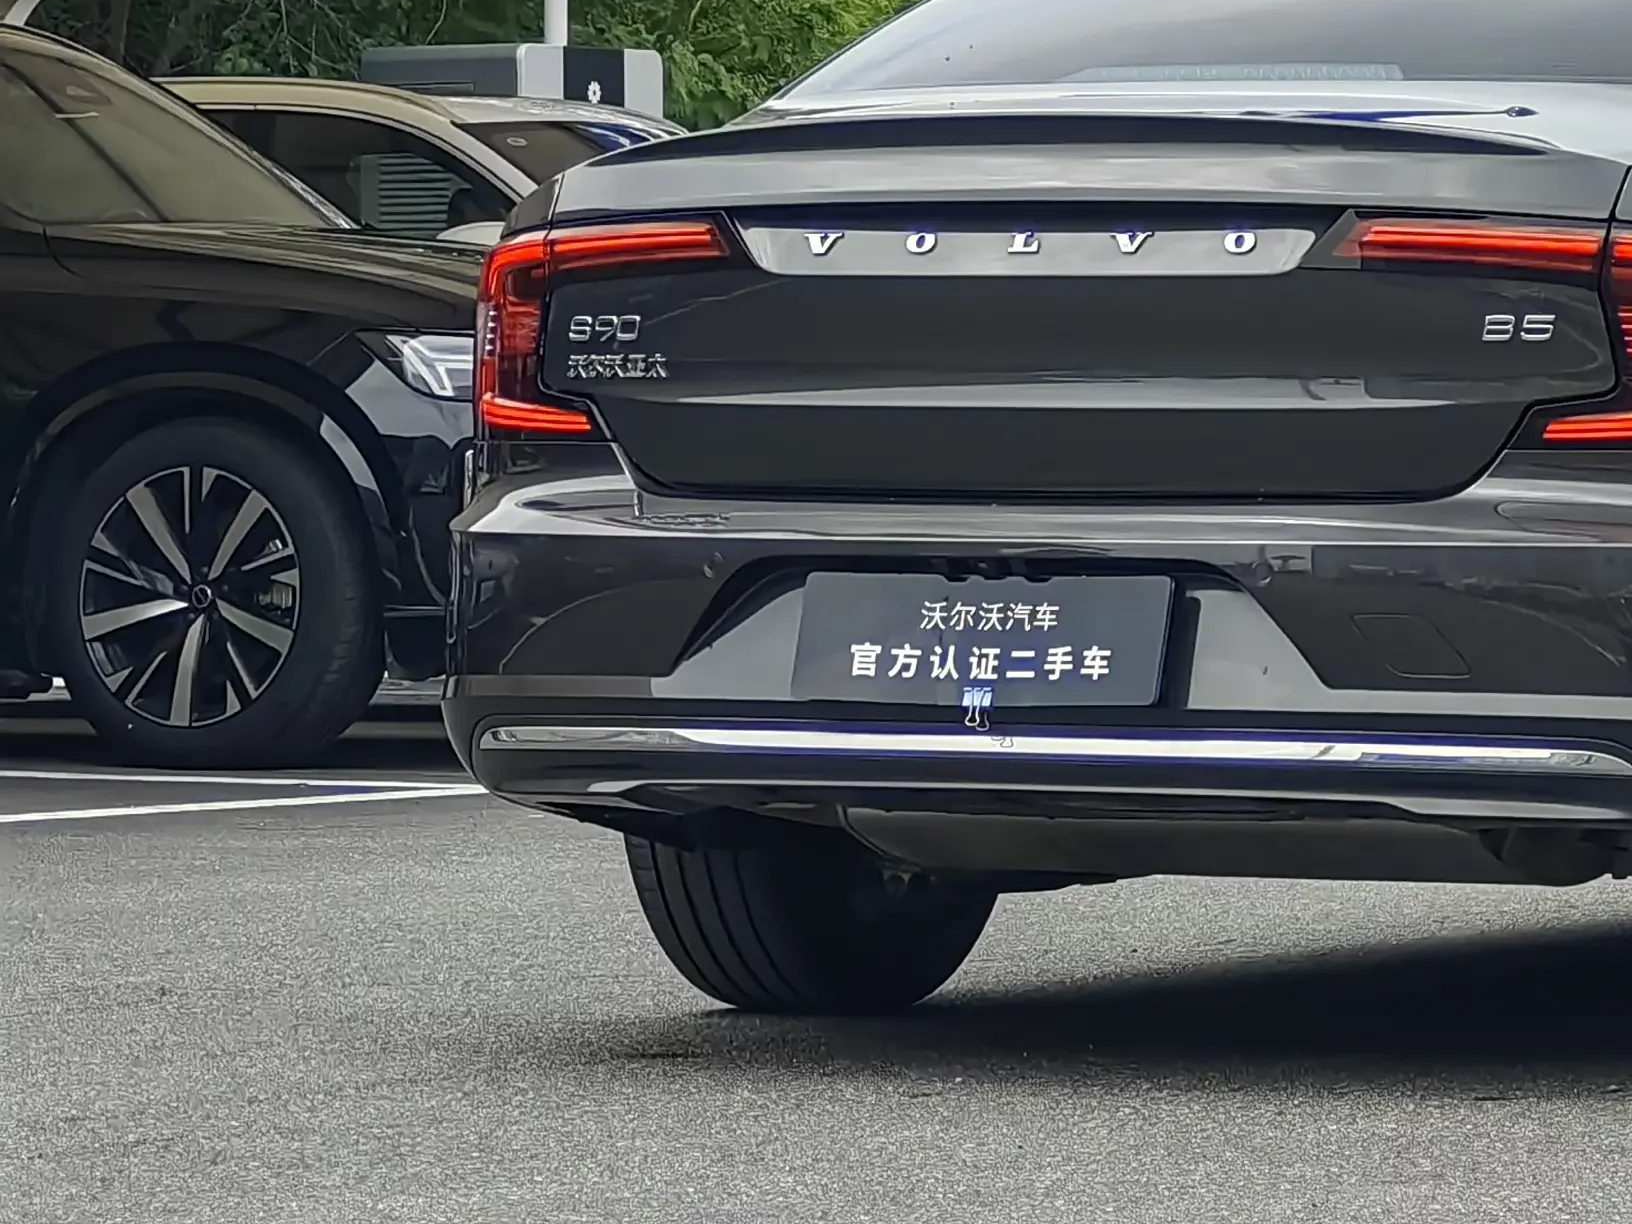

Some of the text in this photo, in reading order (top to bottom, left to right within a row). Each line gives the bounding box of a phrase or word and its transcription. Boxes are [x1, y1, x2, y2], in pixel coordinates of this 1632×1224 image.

[804, 231, 1256, 255] VOLVO
[568, 314, 641, 342] S90
[1481, 314, 1556, 342] B5
[919, 600, 1060, 632] 沃尔沃汽车
[849, 641, 1112, 681] 官方认证二手车
